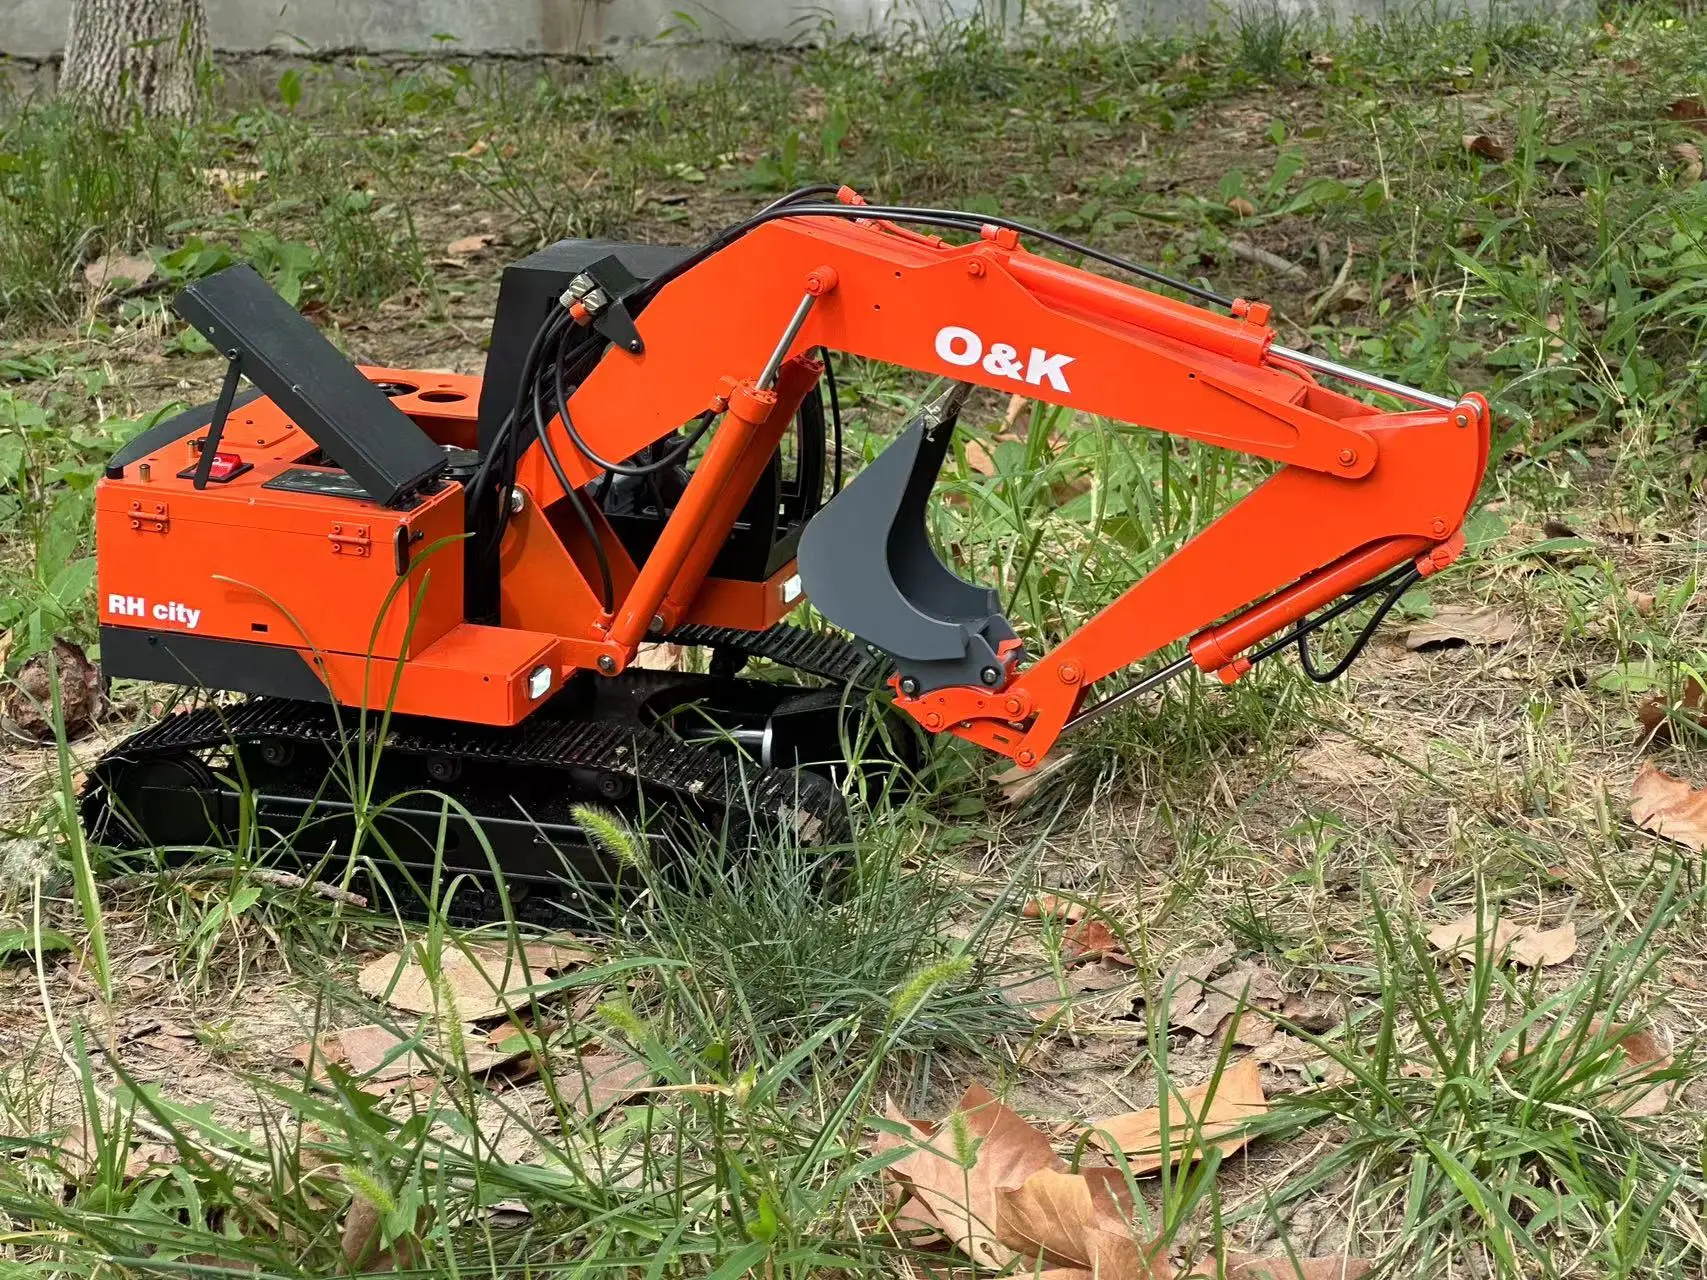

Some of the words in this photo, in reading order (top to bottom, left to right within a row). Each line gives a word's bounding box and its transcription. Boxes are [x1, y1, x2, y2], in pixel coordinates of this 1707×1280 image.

[935, 326, 1076, 393] O&K
[108, 594, 145, 617] RH
[152, 602, 201, 629] city
